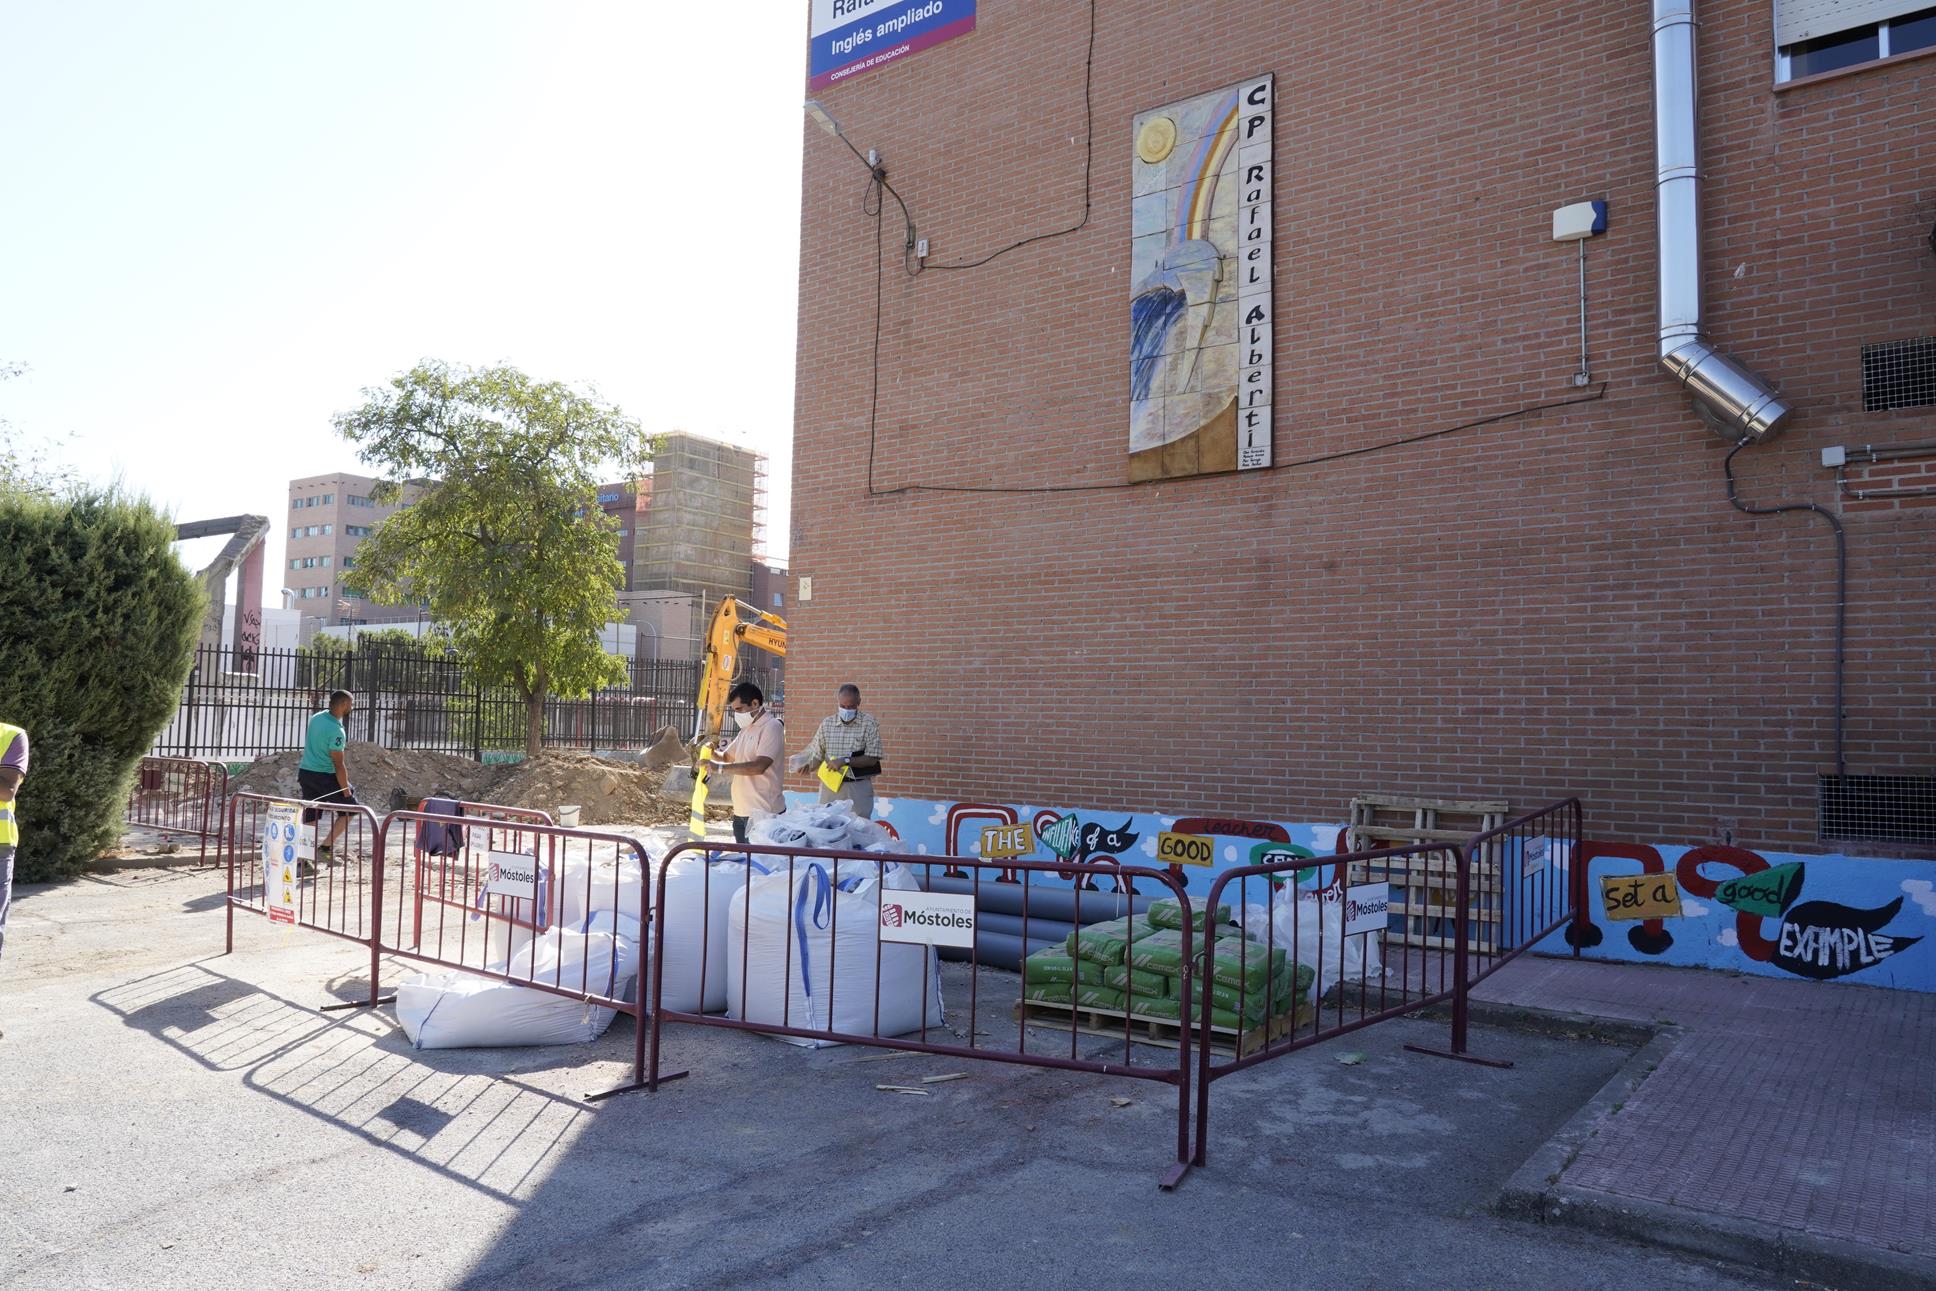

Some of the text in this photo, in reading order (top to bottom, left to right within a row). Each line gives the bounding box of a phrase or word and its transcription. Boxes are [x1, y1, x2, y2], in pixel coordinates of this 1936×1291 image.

[831, 0, 943, 55] Inglés ampliado
[830, 44, 910, 81] CONSEJERÍA DE EDUCACIÓN
[1245, 304, 1265, 448] Alberti
[768, 637, 787, 648] HYUN
[985, 827, 1026, 852] THE
[1107, 833, 1121, 847] a
[1160, 837, 1212, 862] GOOD
[500, 868, 534, 884] Móstoles
[1652, 884, 1675, 904] a
[1723, 874, 1784, 906] good
[904, 910, 973, 928] Móstoles
[1356, 900, 1388, 917] Móstoles
[1780, 922, 1895, 971] EXAMPLE
